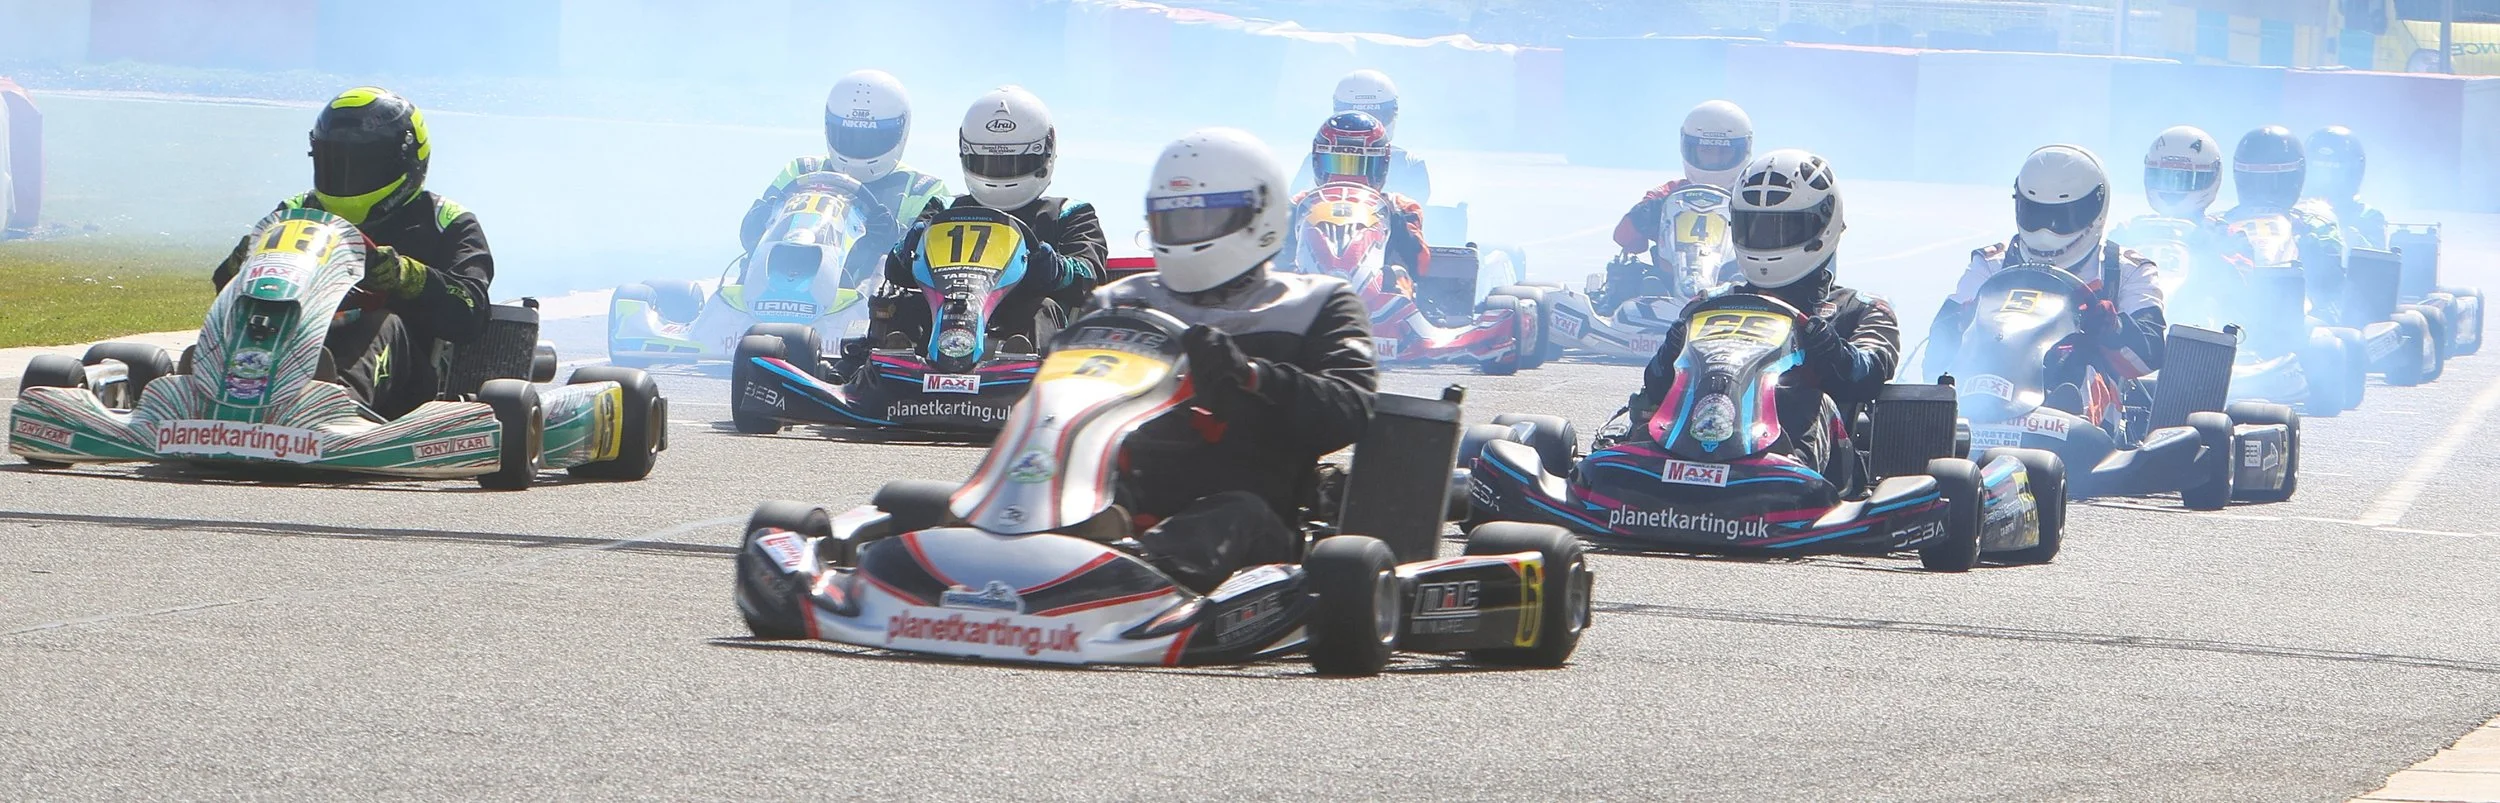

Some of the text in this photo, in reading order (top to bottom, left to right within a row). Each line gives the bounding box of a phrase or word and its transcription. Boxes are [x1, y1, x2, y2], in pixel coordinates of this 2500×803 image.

[842, 120, 878, 129] NKRA
[852, 110, 870, 118] OMP
[987, 121, 1013, 132] Arai
[1331, 146, 1364, 155] NKRA
[1689, 215, 1709, 242] 4
[946, 224, 992, 264] 17
[757, 302, 814, 313] IAME
[2005, 289, 2035, 311] 5
[43, 427, 71, 445] KART
[158, 421, 320, 458] planetkarting.uk
[418, 436, 488, 457] TONY KART
[1608, 504, 1770, 540] planetkarting.uk
[886, 610, 1083, 655] planetkarting.uk
